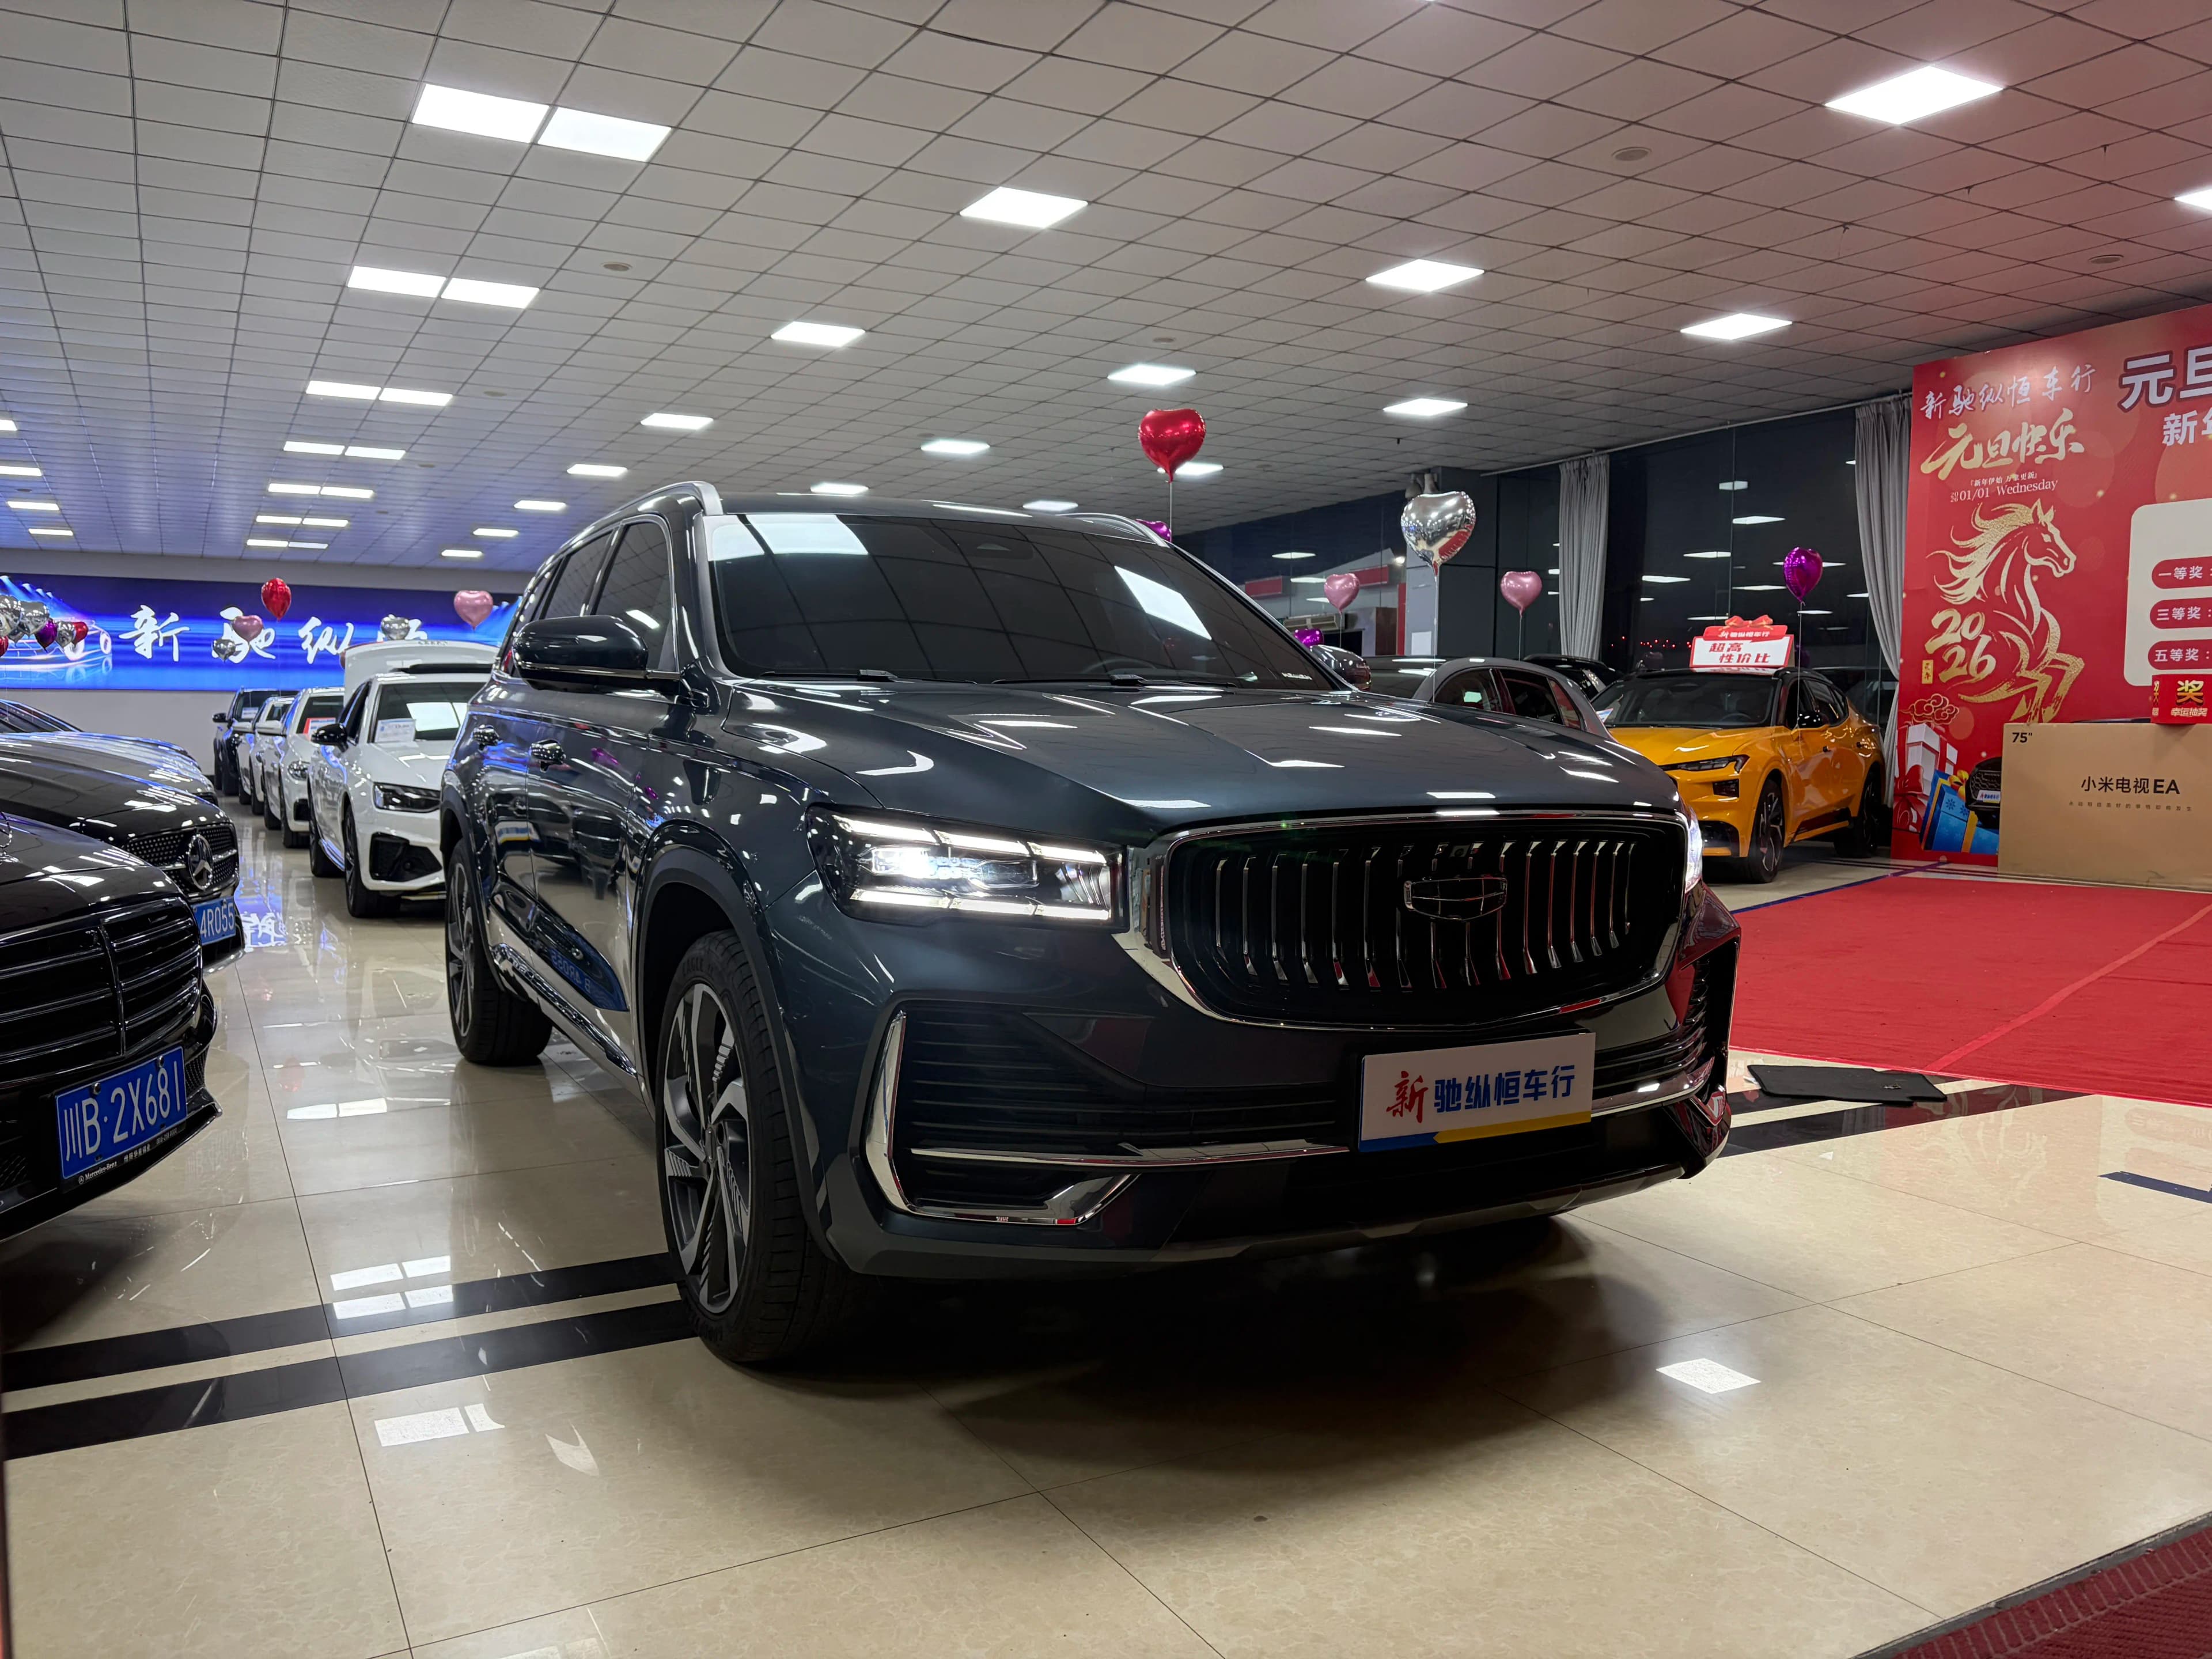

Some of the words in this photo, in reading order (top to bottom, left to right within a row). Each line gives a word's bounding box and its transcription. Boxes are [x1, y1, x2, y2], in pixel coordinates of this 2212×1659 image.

[1921, 364, 2096, 419] 新驰纵恒车行
[1921, 408, 2084, 480] 元旦快乐
[1960, 487, 1990, 501] 01/01
[1997, 479, 2058, 497] Wednesday
[1709, 643, 1743, 653] 超高
[1719, 653, 1771, 663] 性价比
[2176, 680, 2205, 704] 奖
[1386, 1065, 1575, 1124] 新驰纵恒车行
[85, 1161, 118, 1181] Mercedes-Benz
